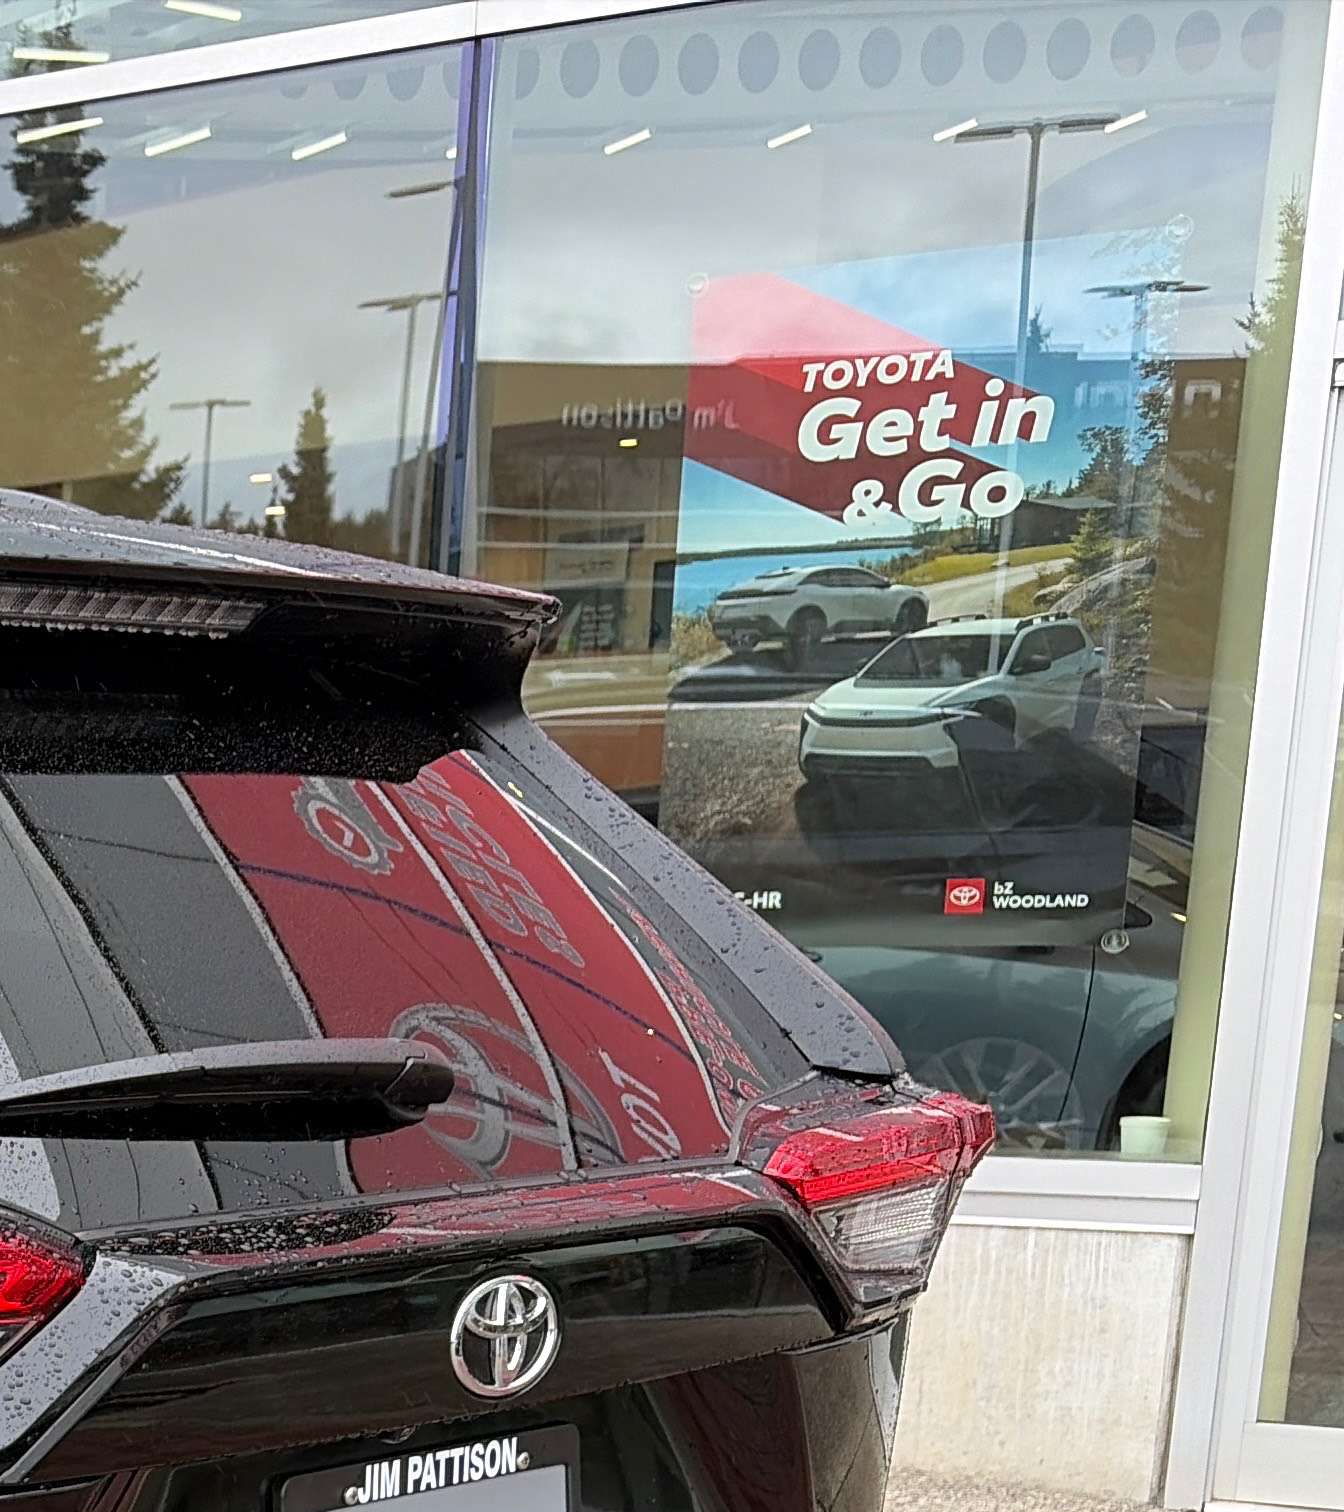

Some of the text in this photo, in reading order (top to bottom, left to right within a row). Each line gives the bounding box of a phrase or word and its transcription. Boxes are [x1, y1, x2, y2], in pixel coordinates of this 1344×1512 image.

[802, 349, 955, 393] TOYOTA
[797, 391, 958, 463] Get
[971, 378, 1055, 448] in
[992, 894, 1090, 910] WOODLAND
[993, 881, 1014, 895] bZ
[357, 1436, 520, 1504] JIM PATTISON
